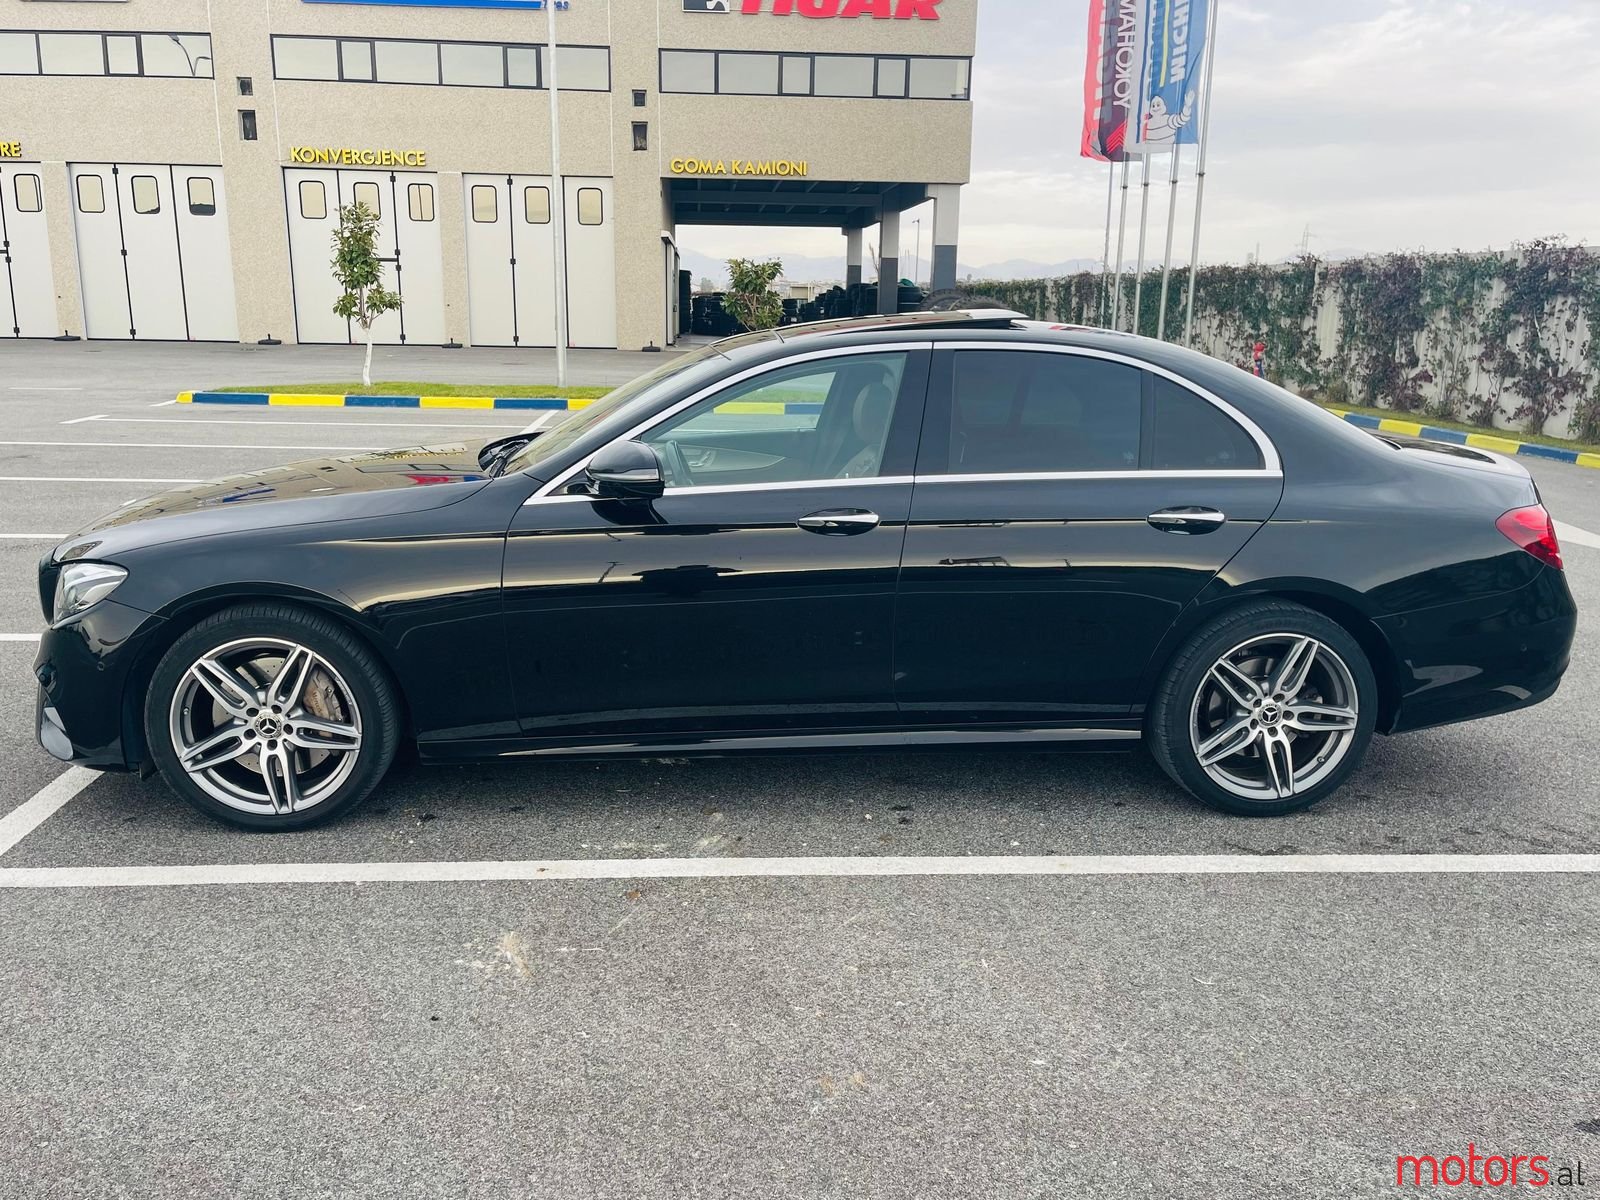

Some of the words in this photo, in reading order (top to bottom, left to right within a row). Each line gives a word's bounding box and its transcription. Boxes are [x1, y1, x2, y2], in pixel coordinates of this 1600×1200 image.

[290, 146, 427, 167] KONVERGJENCE
[670, 157, 727, 175] GOMA
[731, 159, 808, 176] KAMIONI
